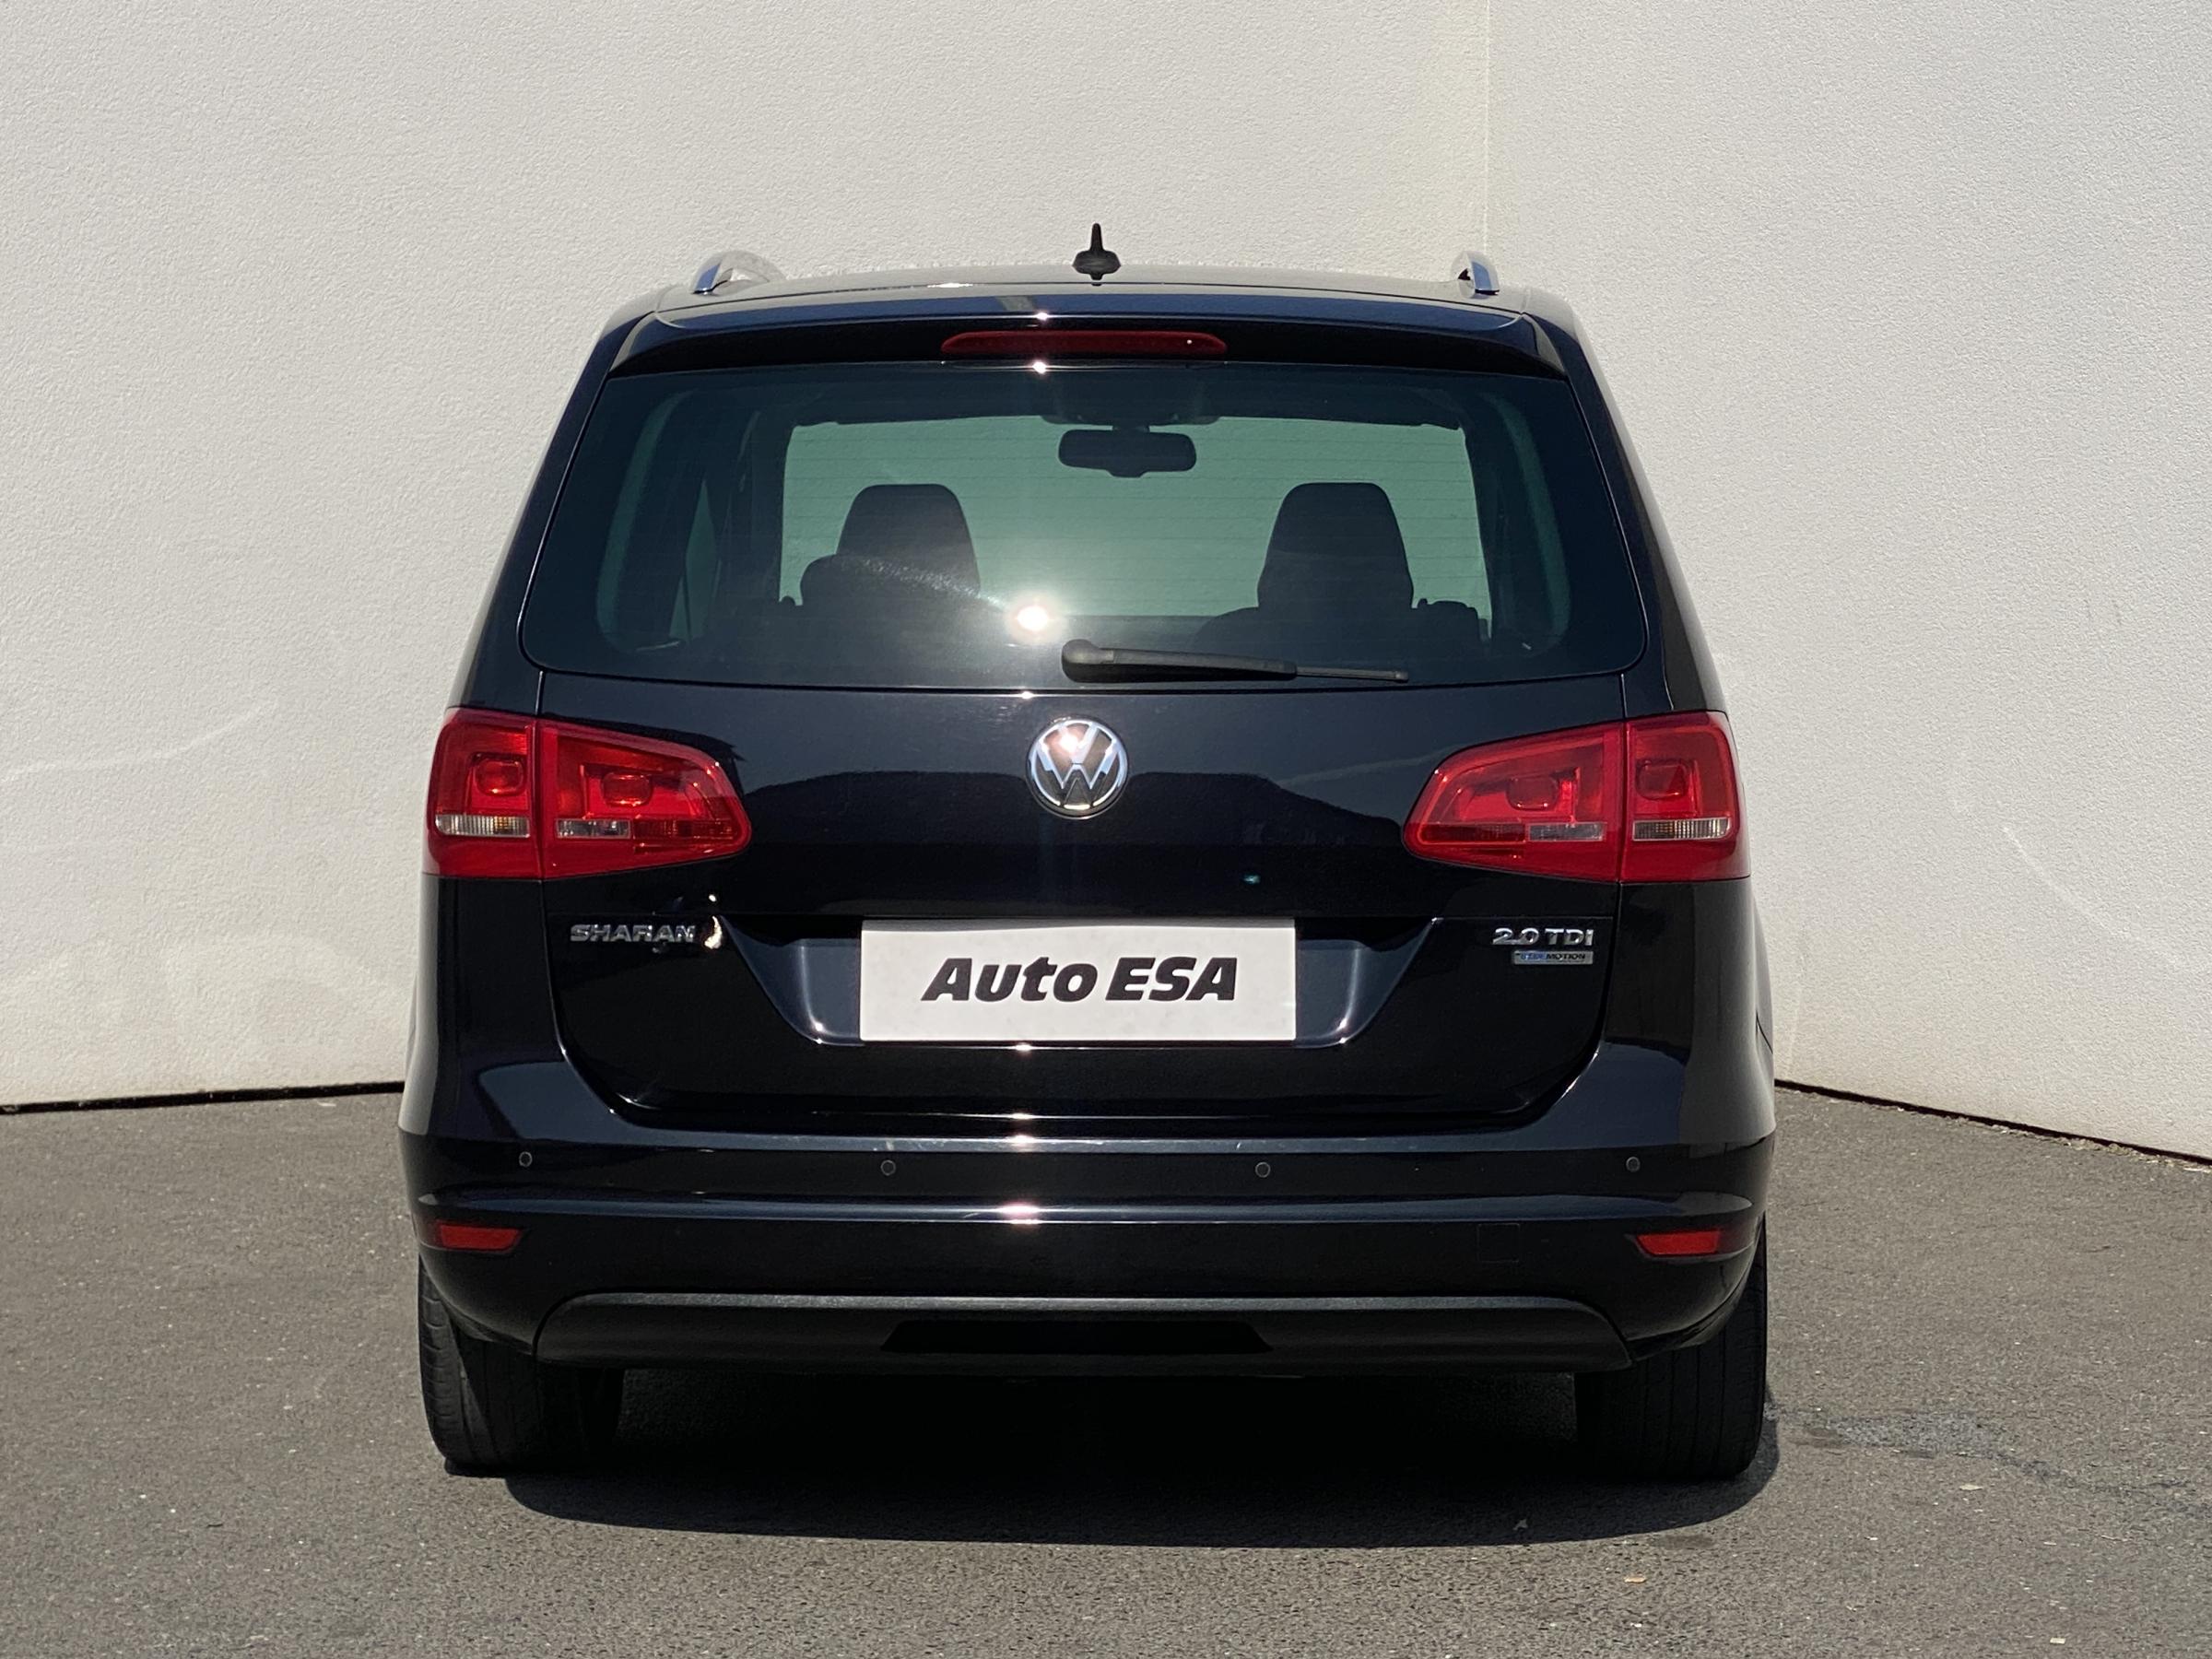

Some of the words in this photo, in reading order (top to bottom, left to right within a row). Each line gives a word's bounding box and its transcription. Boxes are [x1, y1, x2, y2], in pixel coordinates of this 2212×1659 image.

[570, 924, 696, 942] SHARAN
[1492, 927, 1540, 946] 2.0
[1545, 928, 1594, 946] TDI
[920, 957, 1098, 1002] Auto
[1105, 957, 1238, 1001] ESA
